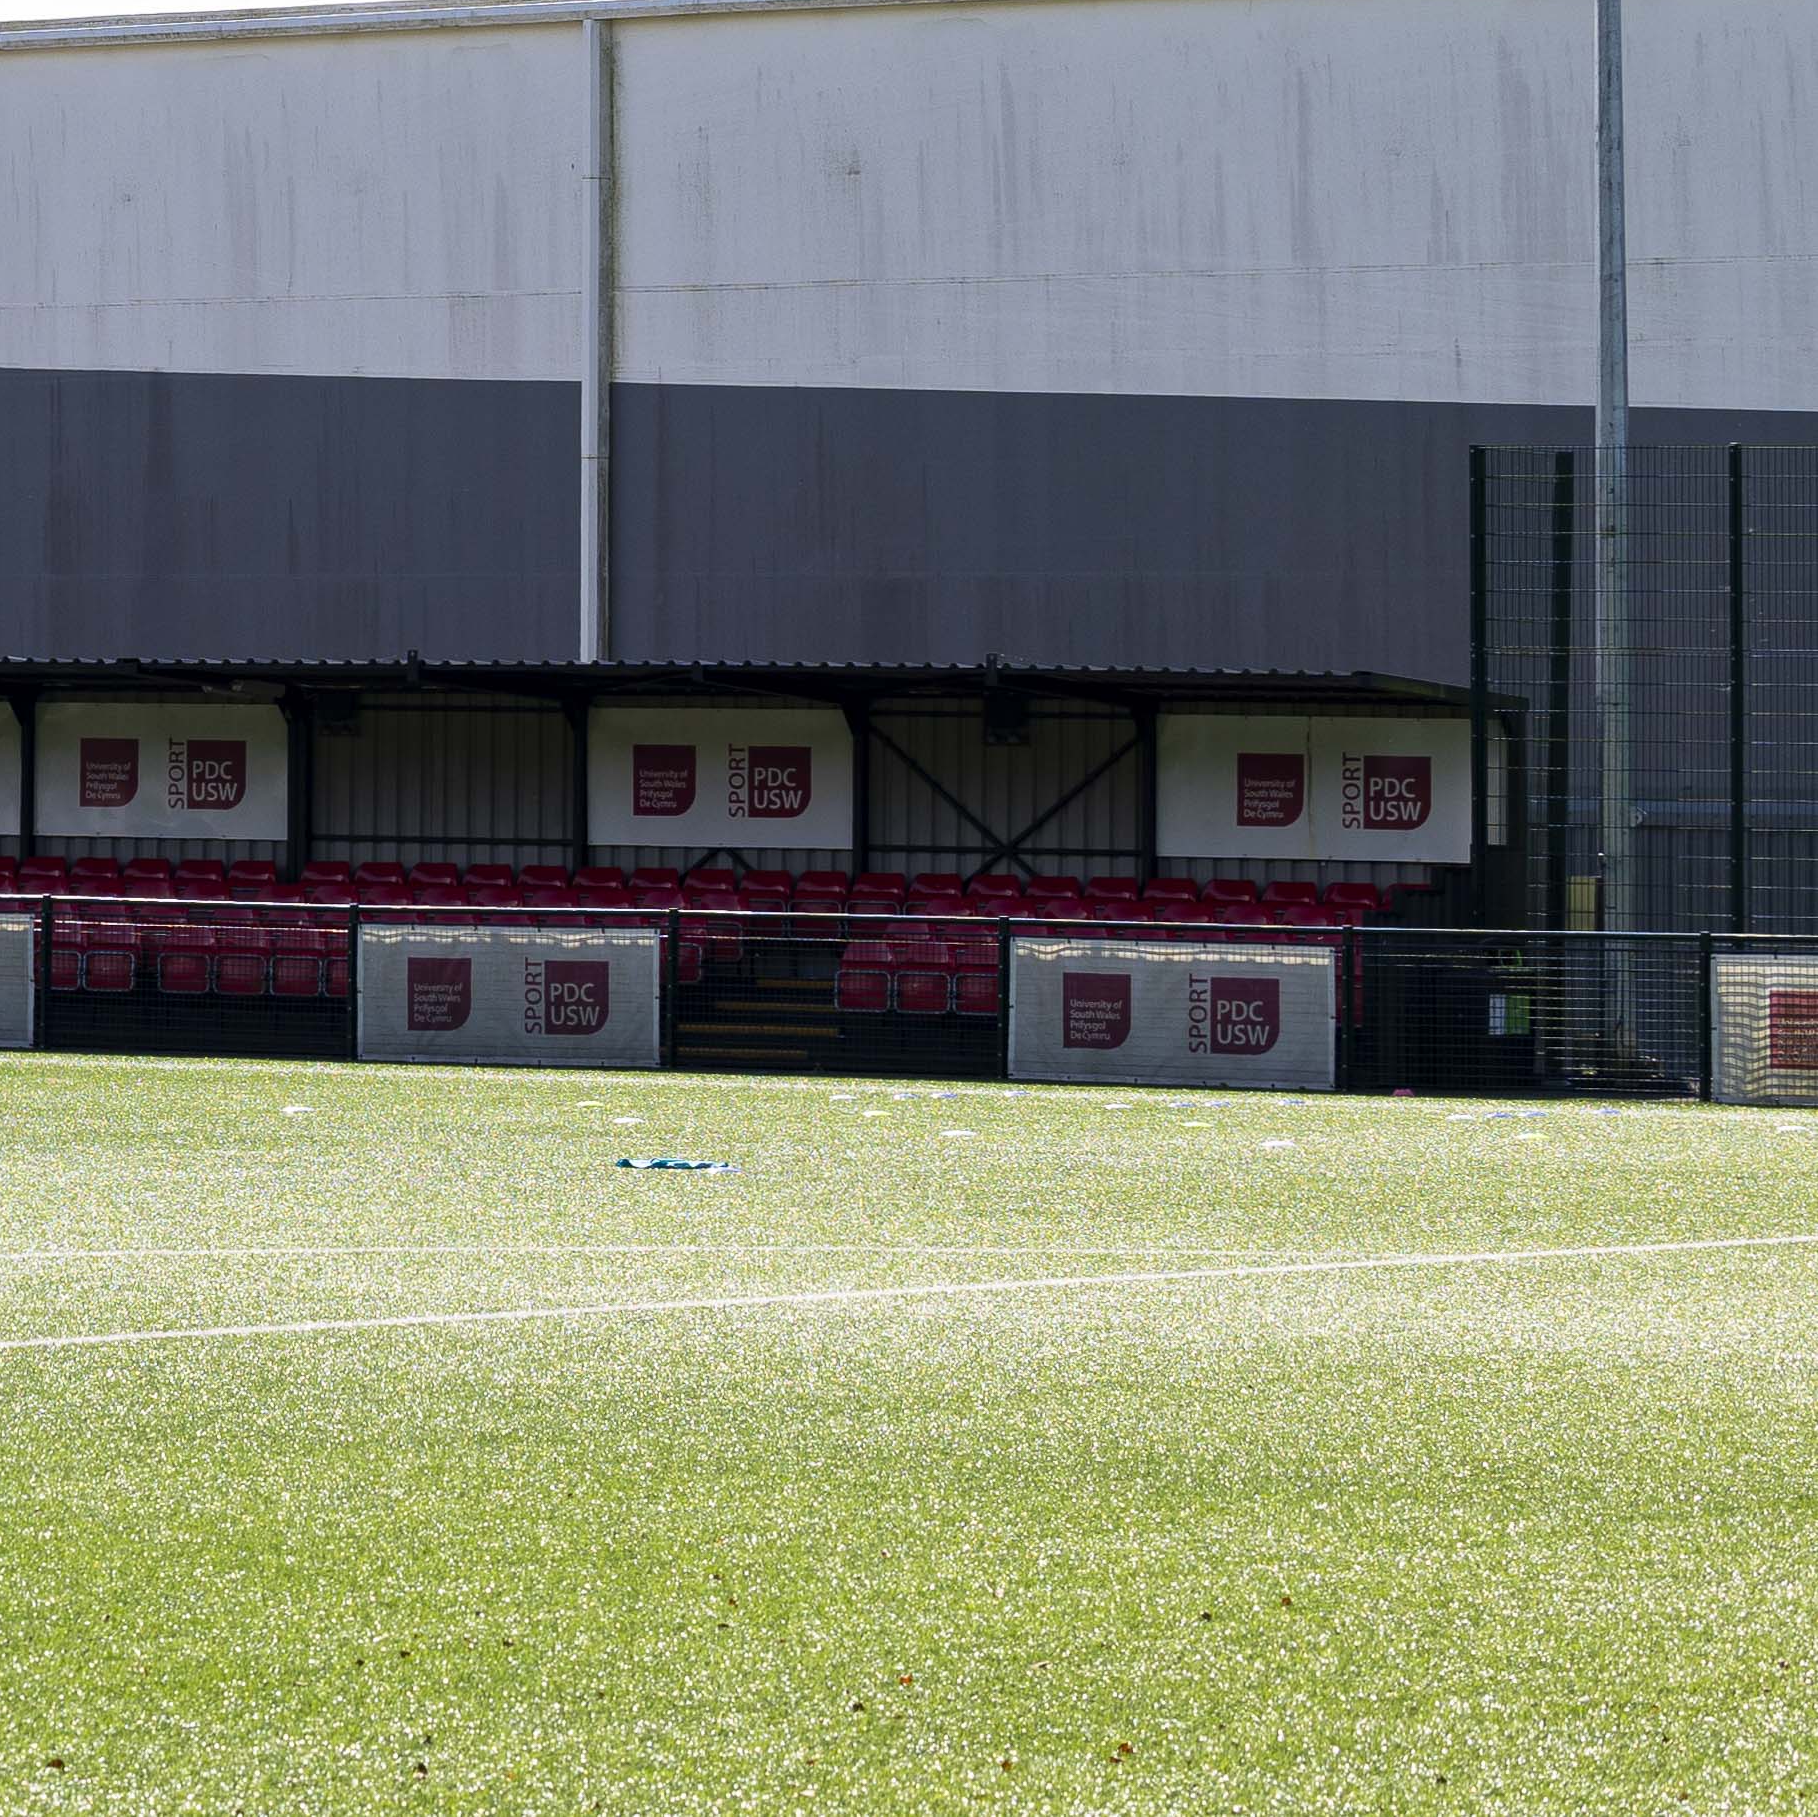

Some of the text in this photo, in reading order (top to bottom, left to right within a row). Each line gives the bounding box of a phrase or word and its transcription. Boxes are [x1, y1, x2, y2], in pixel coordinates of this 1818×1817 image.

[168, 738, 185, 809] SPORT
[193, 761, 232, 779] PDC
[754, 768, 796, 786] PDC
[729, 744, 745, 817] SPORT
[1343, 752, 1360, 828] SPORT
[1370, 778, 1415, 797] PDC
[192, 783, 237, 801] USW
[754, 790, 802, 809] USW
[1370, 802, 1421, 821] USW
[525, 957, 542, 1034] SPORT
[550, 983, 594, 1002] PDC
[1070, 999, 1112, 1009] University
[1217, 1000, 1264, 1021] PDC
[551, 1006, 599, 1025] USW
[1070, 1010, 1120, 1019] South Wales
[1189, 974, 1208, 1054] SPORT
[1070, 1020, 1105, 1031] Prifysgol
[1217, 1025, 1269, 1045] USW
[1082, 1031, 1110, 1041] Cymru
